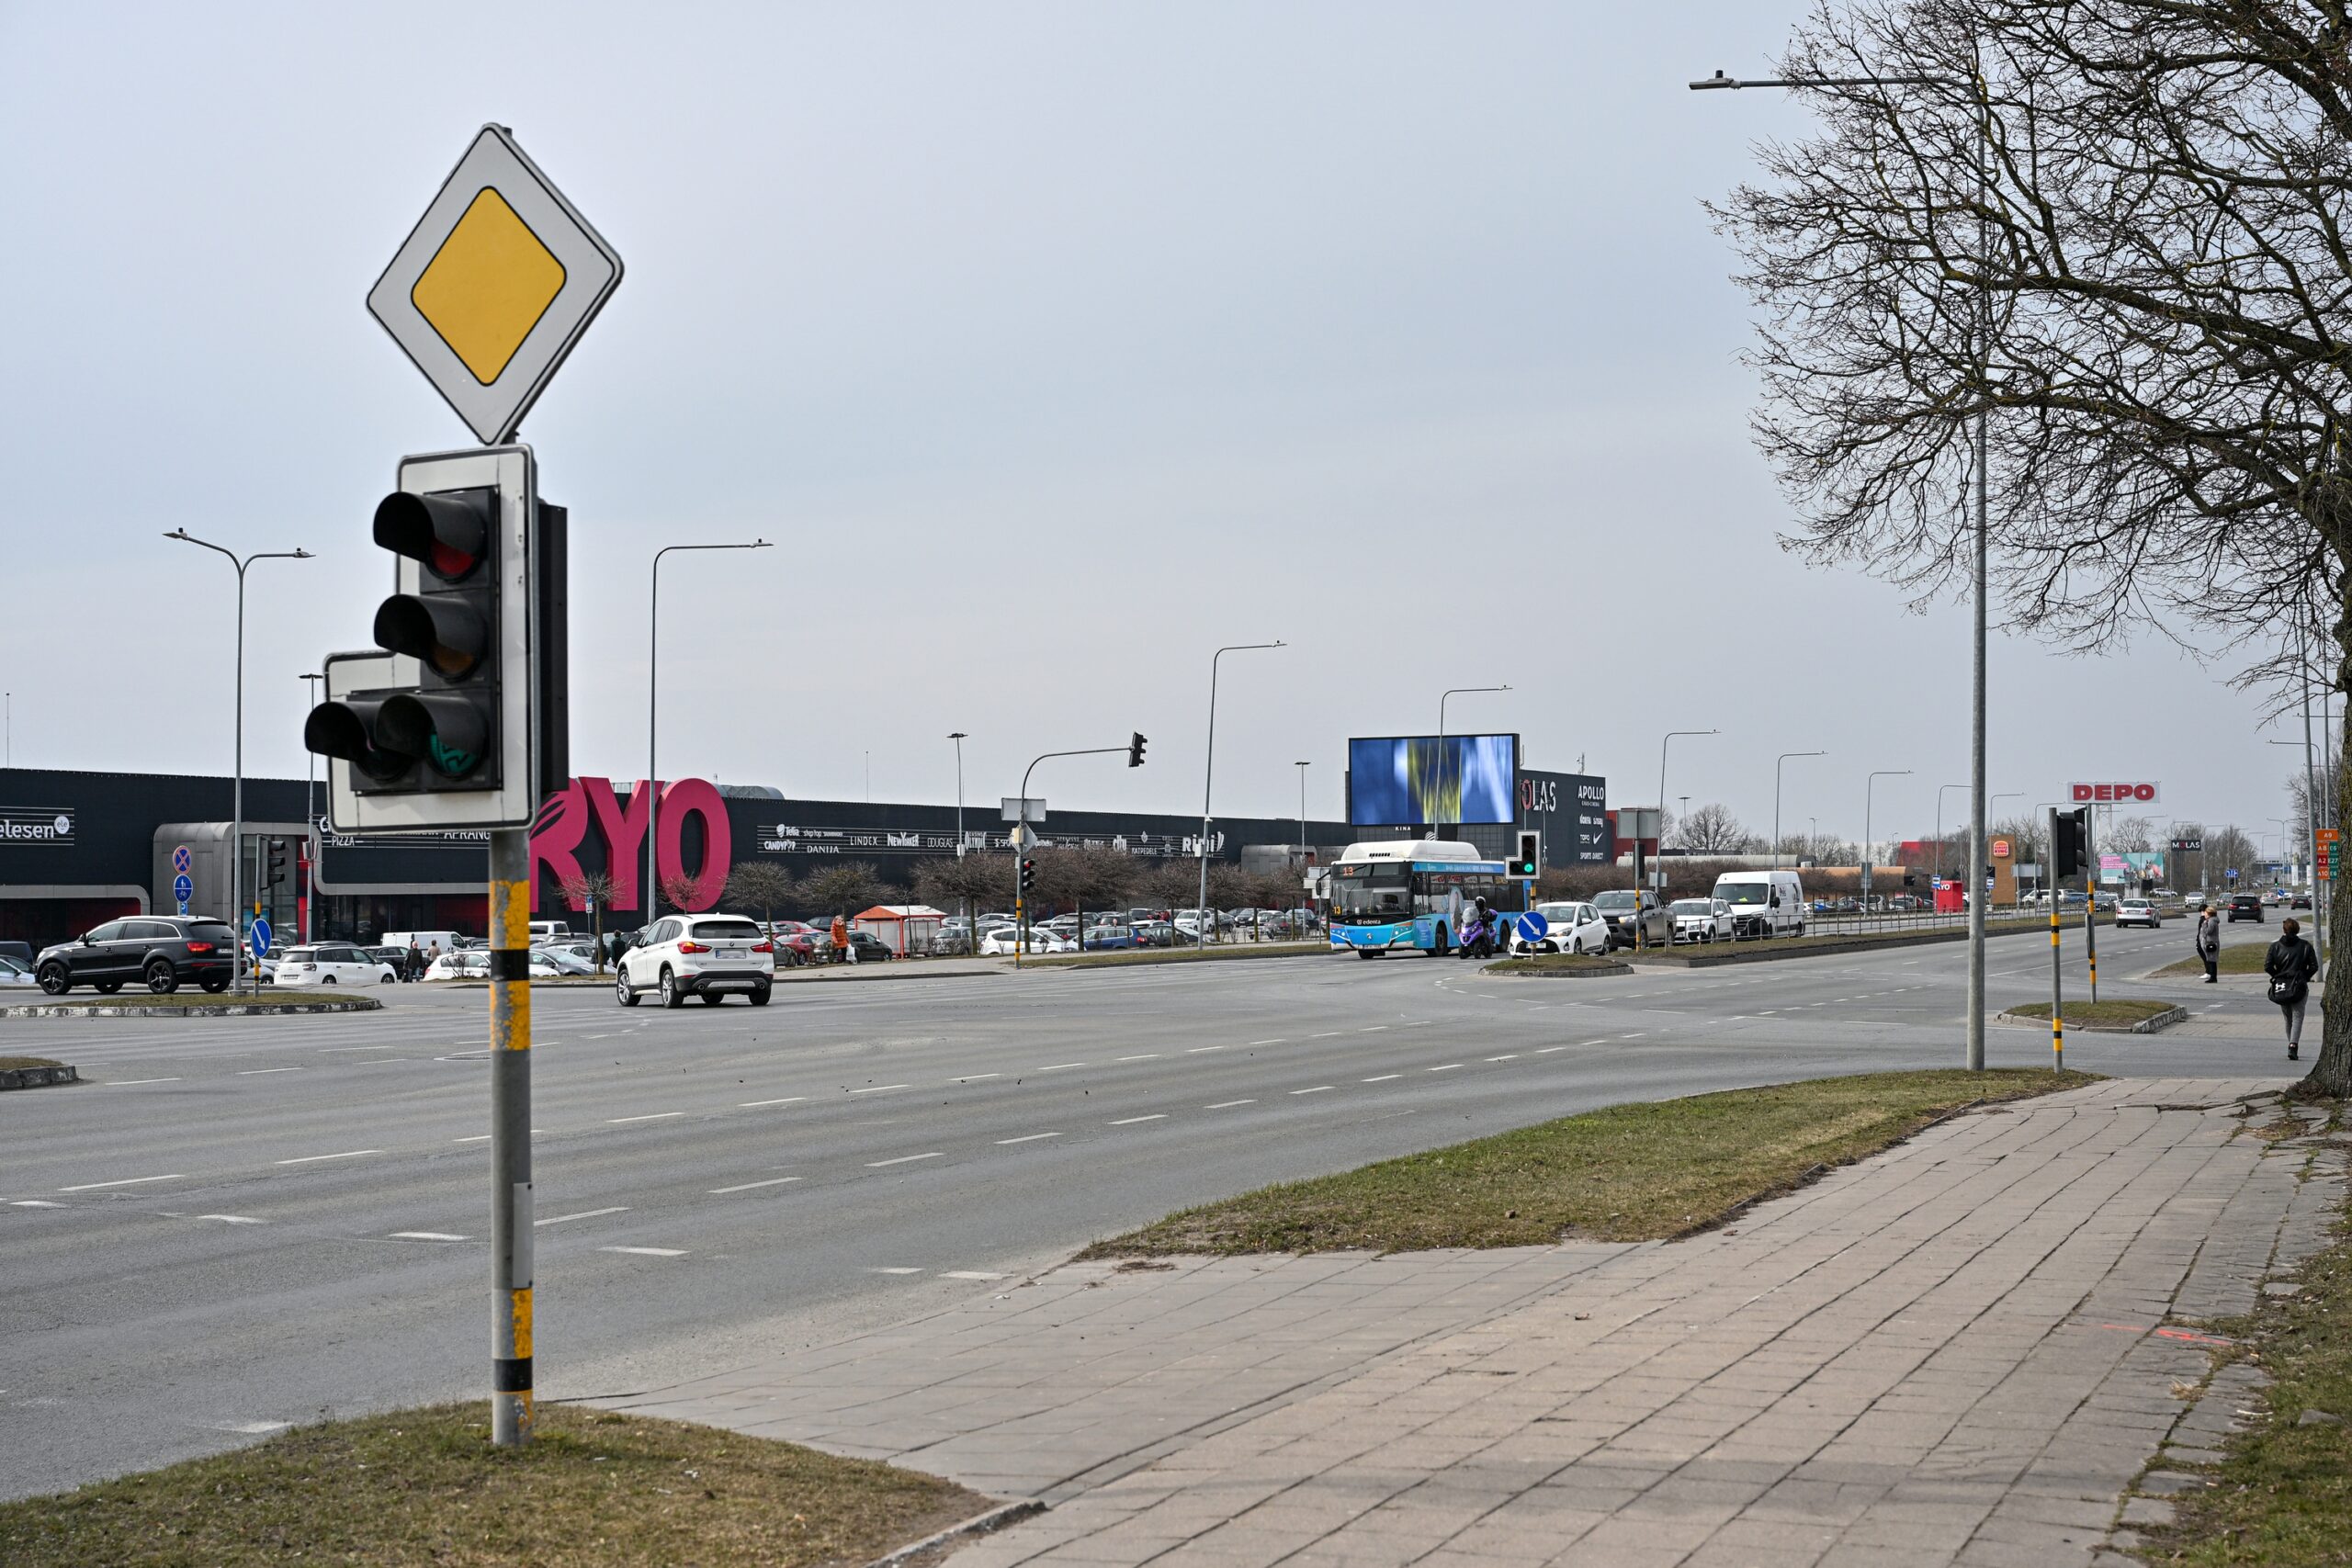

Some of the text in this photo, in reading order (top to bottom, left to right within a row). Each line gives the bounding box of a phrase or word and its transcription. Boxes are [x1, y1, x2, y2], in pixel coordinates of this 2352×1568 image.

[1577, 784, 1604, 800] APOLLO
[2073, 784, 2154, 801] DEPO
[332, 835, 355, 847] PIZZA
[529, 776, 732, 912] RYO
[850, 837, 878, 846] LINDEX
[927, 837, 954, 848] DOUGLAS
[807, 845, 840, 854] DANIJA
[1343, 866, 1353, 876] 13
[1334, 906, 1341, 915] 13
